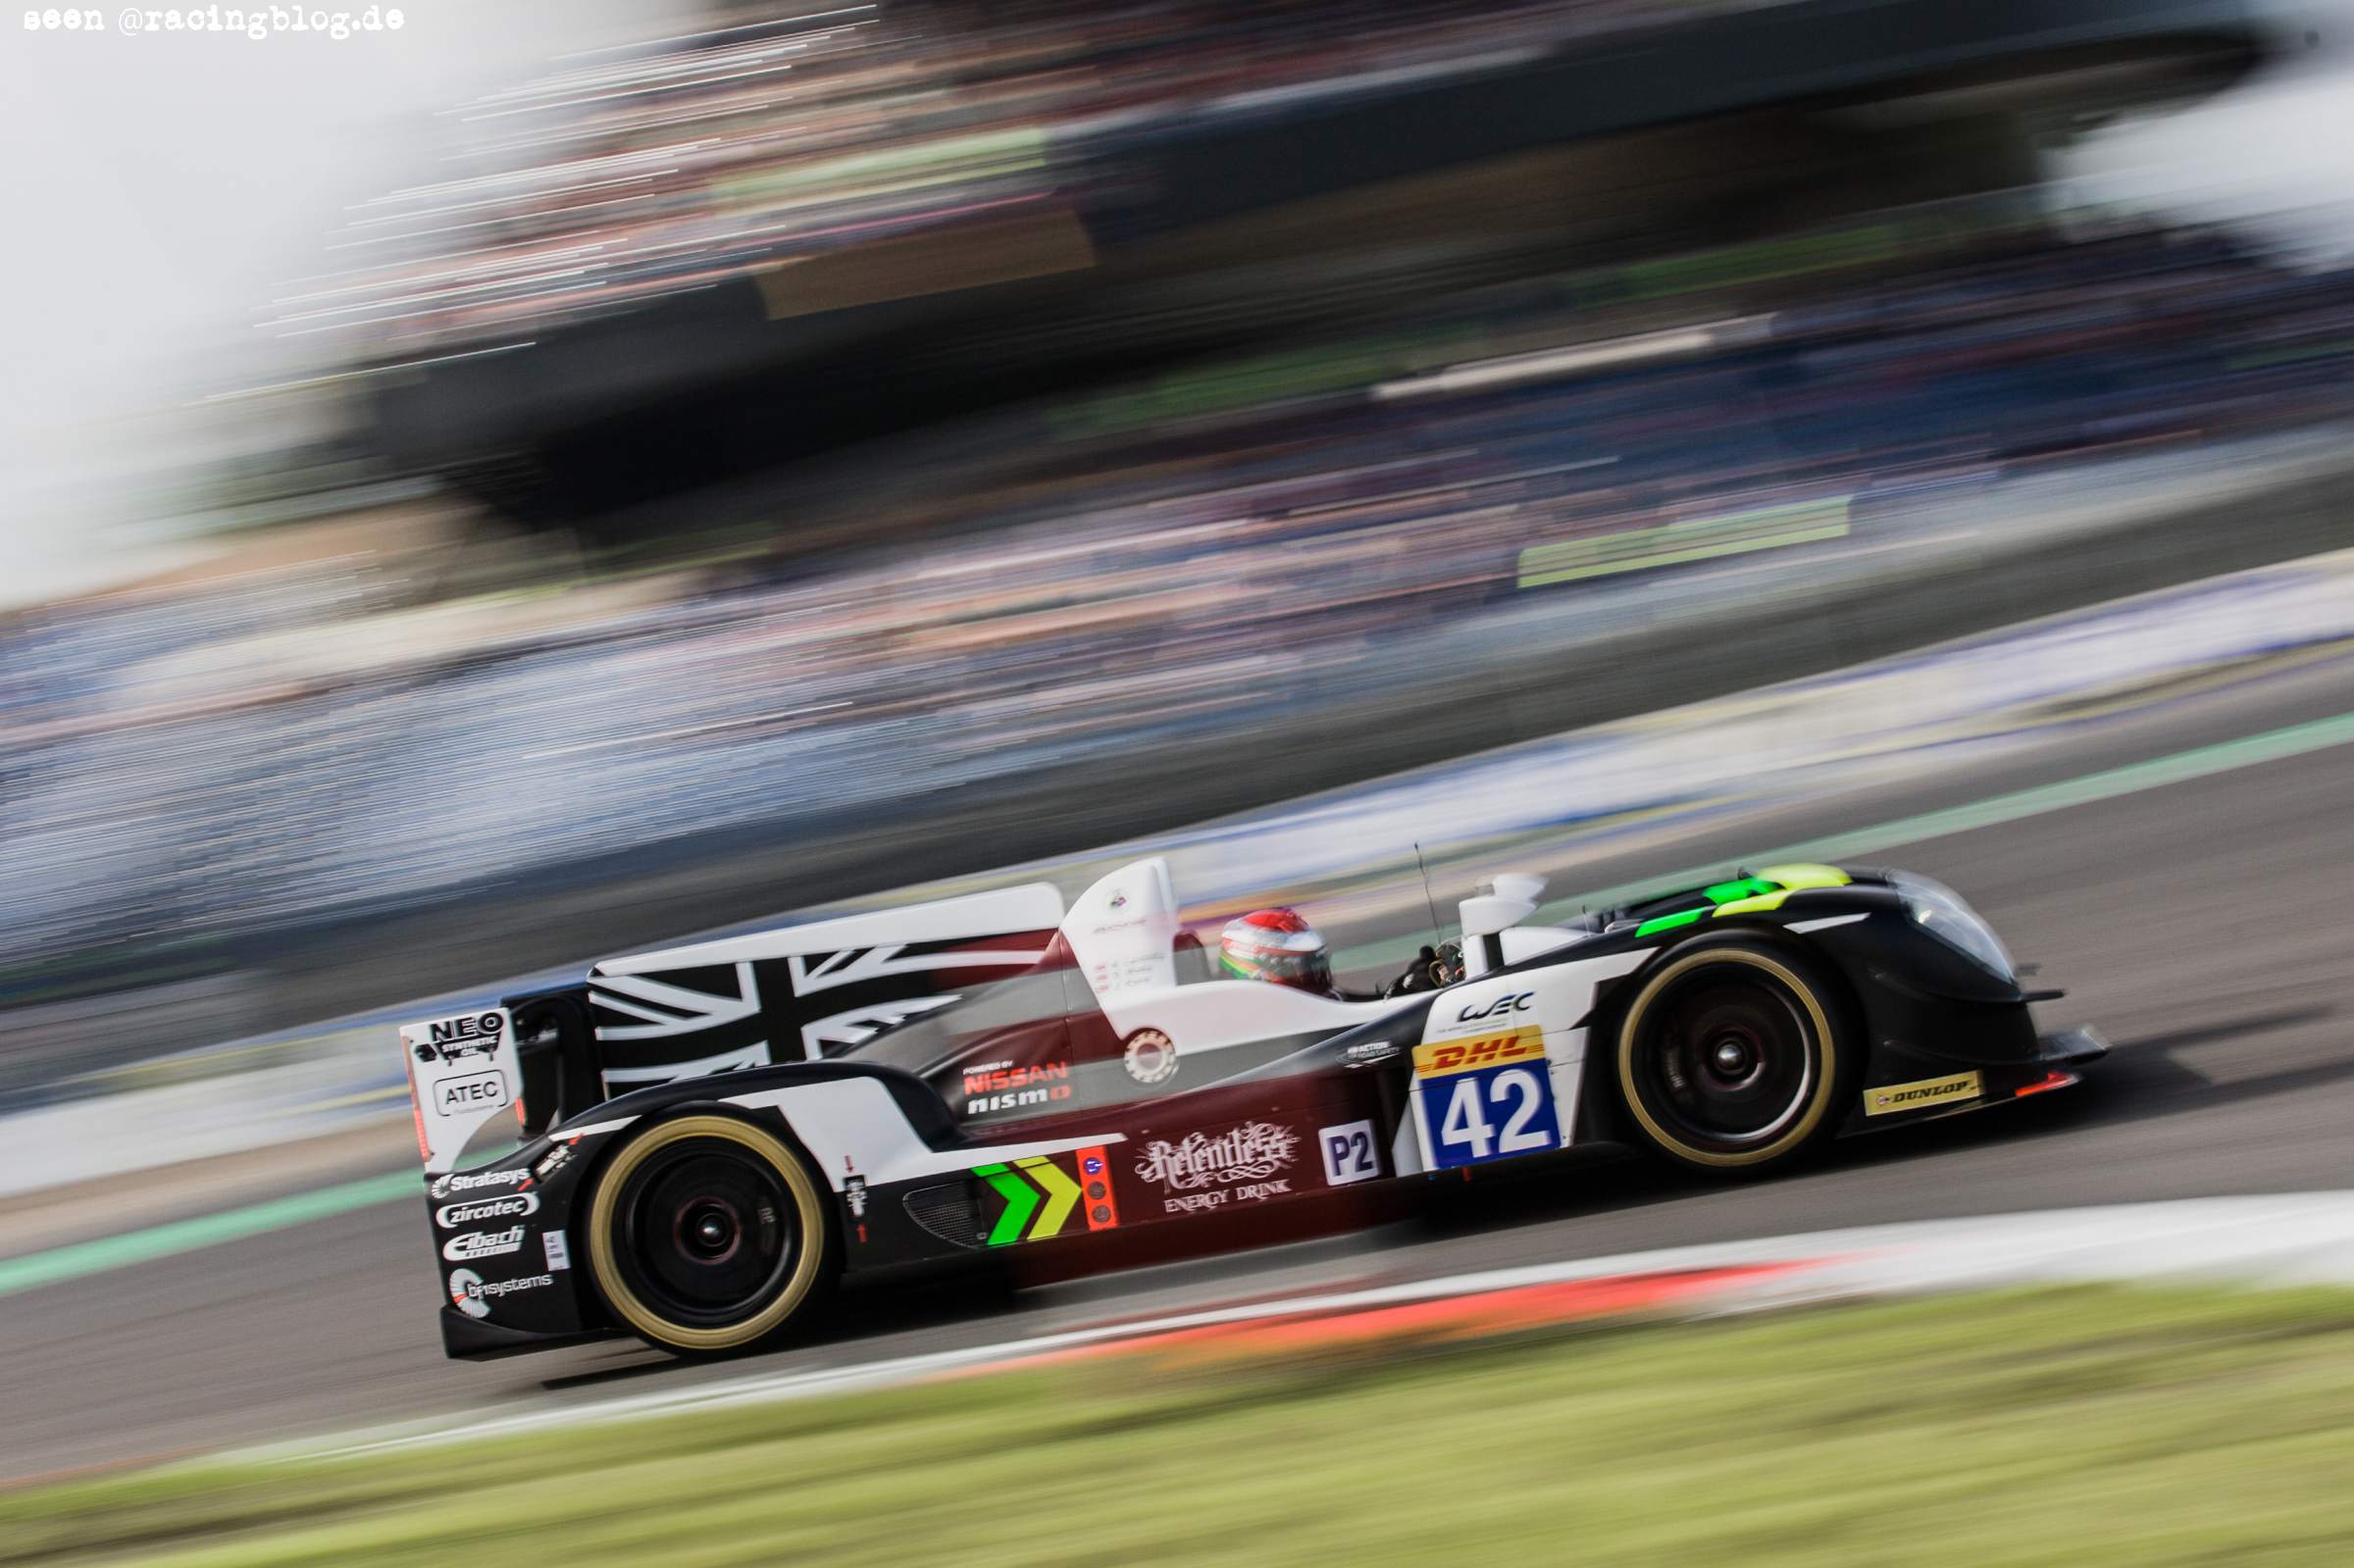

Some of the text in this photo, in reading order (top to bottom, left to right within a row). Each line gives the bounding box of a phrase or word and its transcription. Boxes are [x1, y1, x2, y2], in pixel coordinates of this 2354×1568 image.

[1458, 991, 1536, 1023] WEC
[430, 1012, 504, 1042] NEO
[1431, 1036, 1527, 1070] DHL
[445, 1081, 497, 1105] ATEC
[964, 1061, 1068, 1095] NISSAN
[1892, 1081, 1970, 1103] DUNLOP
[967, 1085, 1071, 1115] nismo
[1441, 1068, 1552, 1159] 42
[1135, 1120, 1301, 1194] Relentless
[1327, 1131, 1373, 1177] P2
[450, 1168, 531, 1192] Stratasys
[1164, 1179, 1292, 1214] ENERGY DRINK
[450, 1199, 525, 1224] zircotec
[442, 1225, 526, 1261] Eibach
